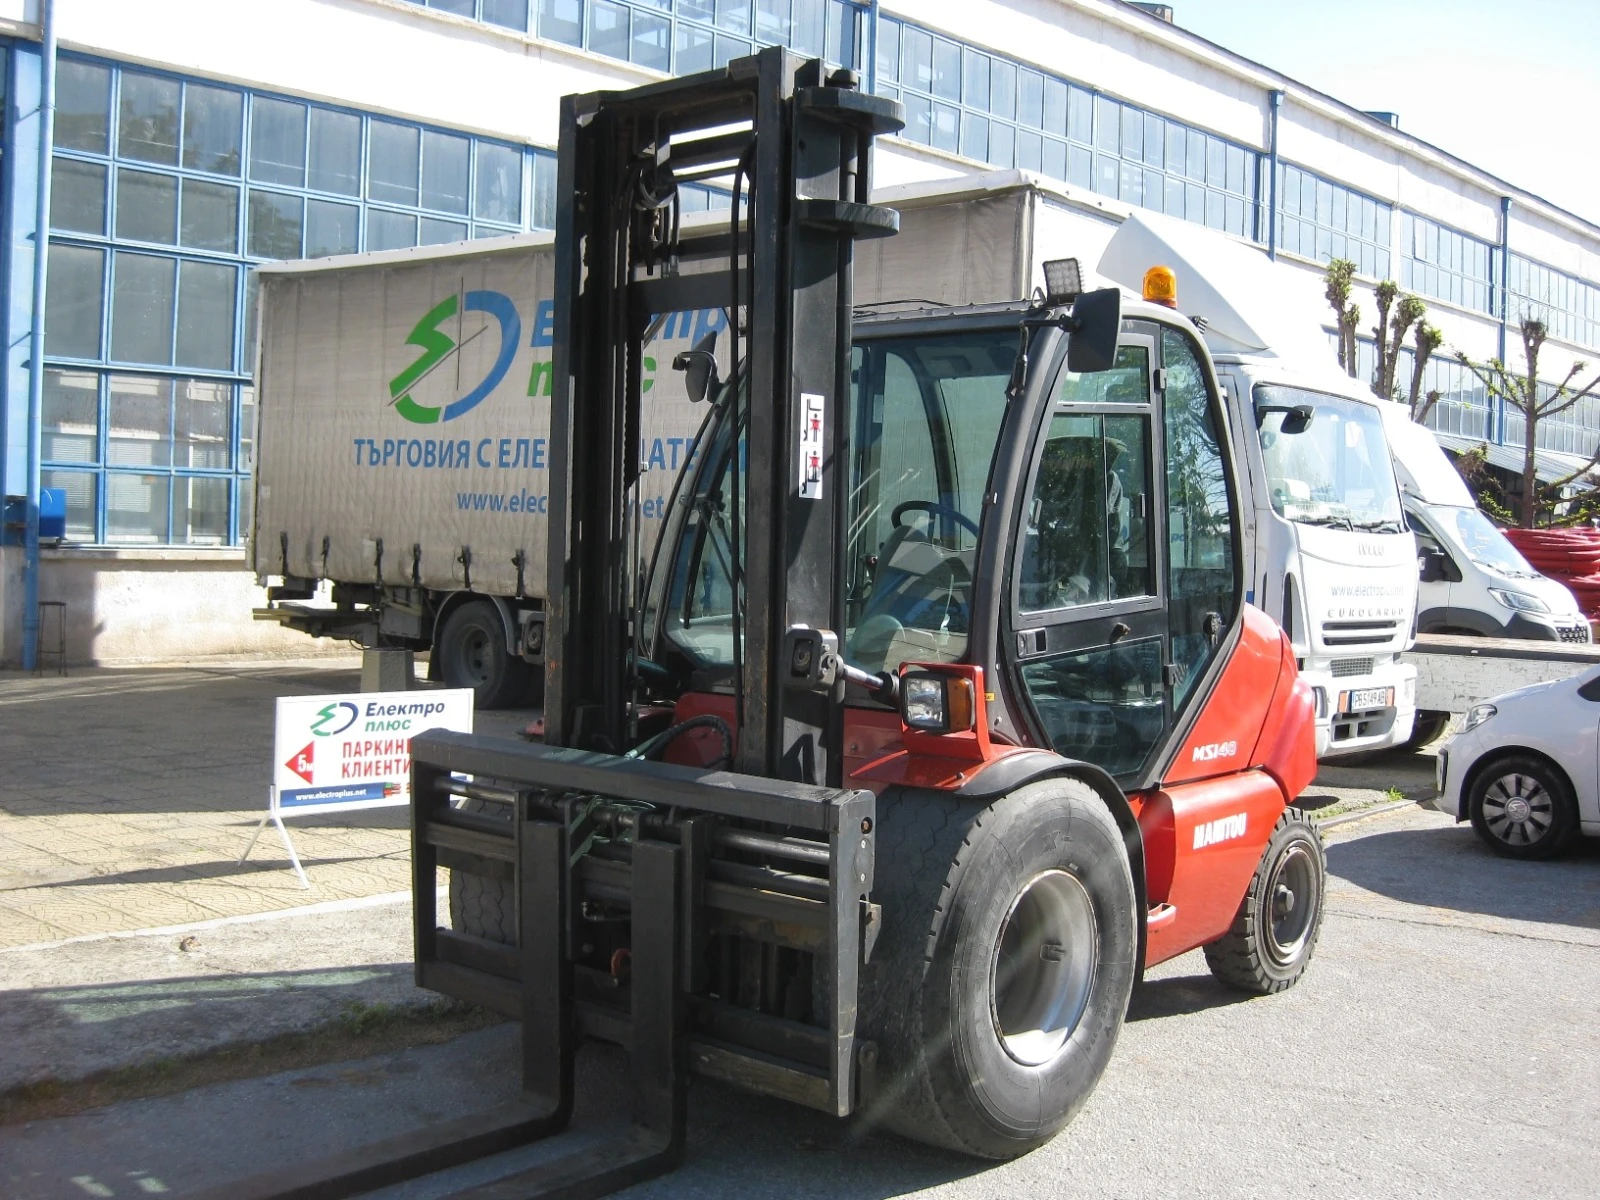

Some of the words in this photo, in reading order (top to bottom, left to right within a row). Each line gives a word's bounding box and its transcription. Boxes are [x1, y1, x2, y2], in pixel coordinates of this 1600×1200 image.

[354, 438, 471, 469] ТЪРГОВИЯ
[476, 438, 492, 468] С
[365, 702, 445, 717] Електро
[365, 720, 411, 732] плюс
[341, 759, 412, 779] КЛИЕНТИ
[295, 789, 367, 801] www.electroplus.net
[1193, 812, 1247, 850] MANITOU
